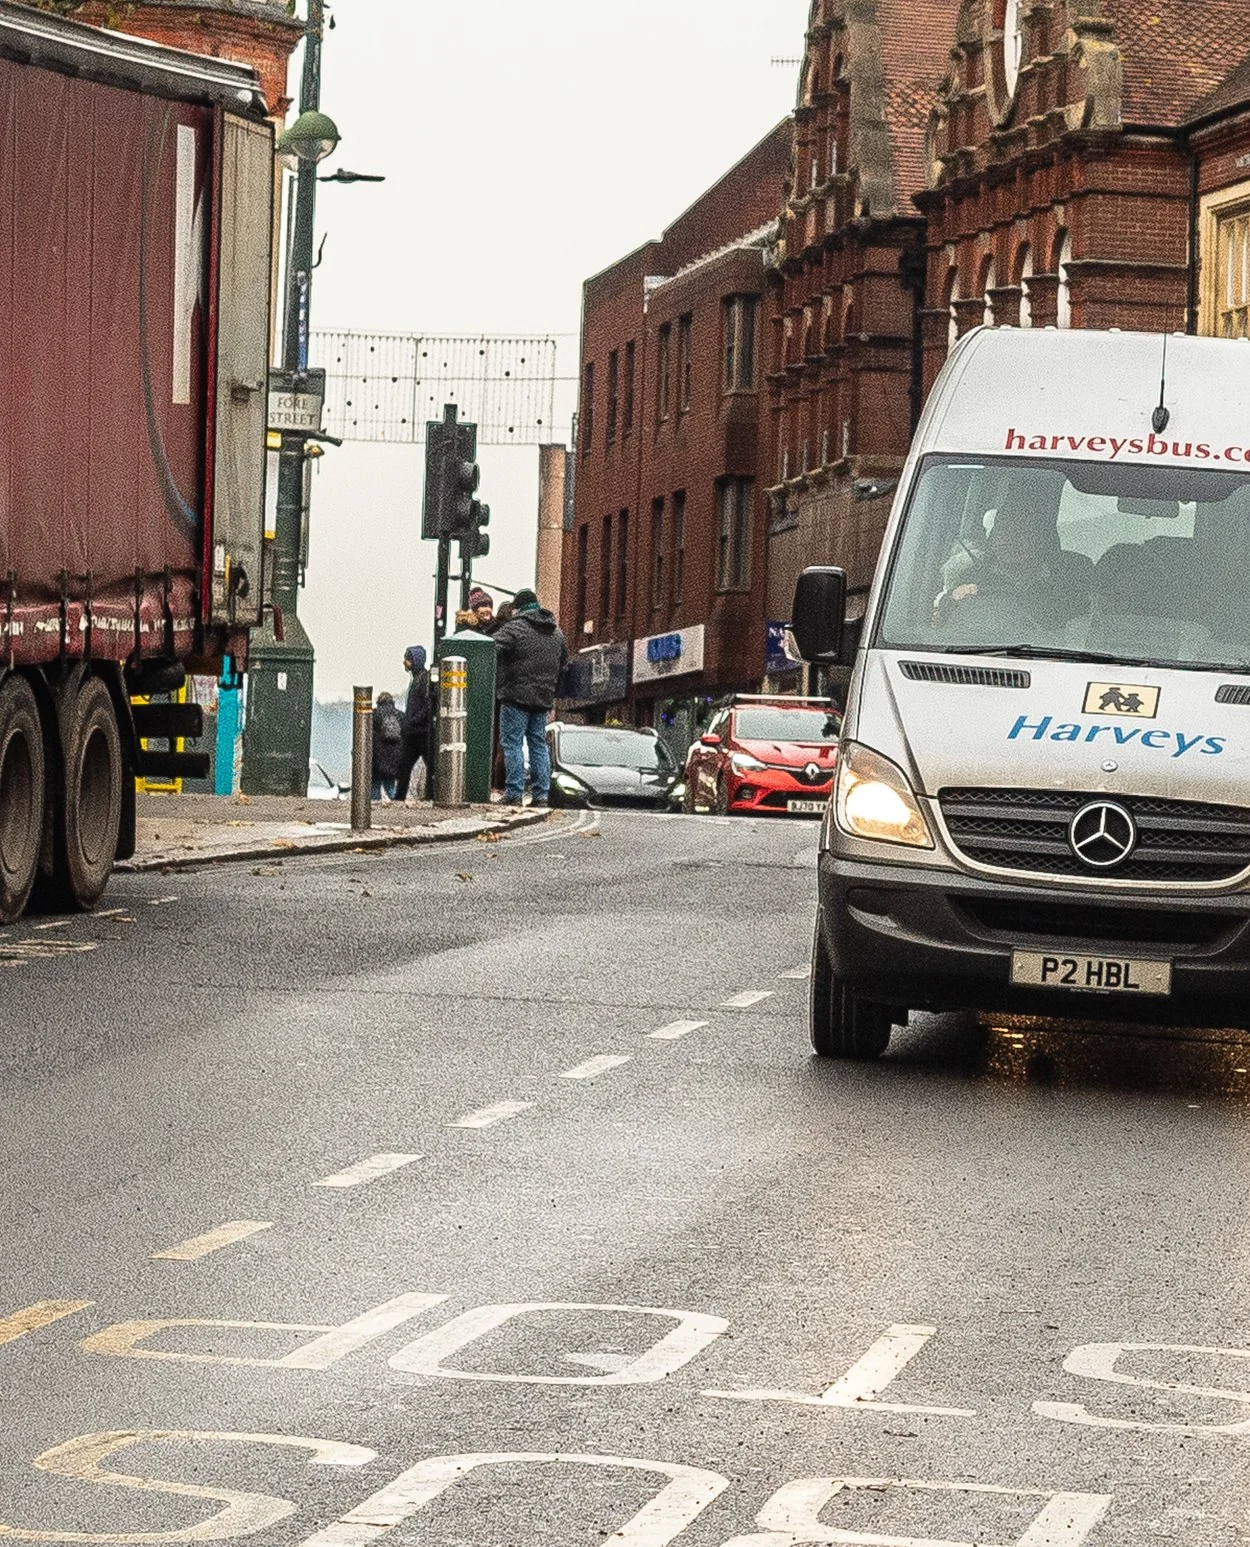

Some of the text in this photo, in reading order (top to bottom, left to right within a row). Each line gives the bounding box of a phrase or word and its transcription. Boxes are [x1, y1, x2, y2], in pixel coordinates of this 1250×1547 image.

[270, 411, 316, 426] STREET
[277, 395, 309, 410] FORE
[1006, 714, 1227, 758] Harveys
[1041, 956, 1140, 990] P2 HBL
[0, 1430, 1113, 1547] BUS
